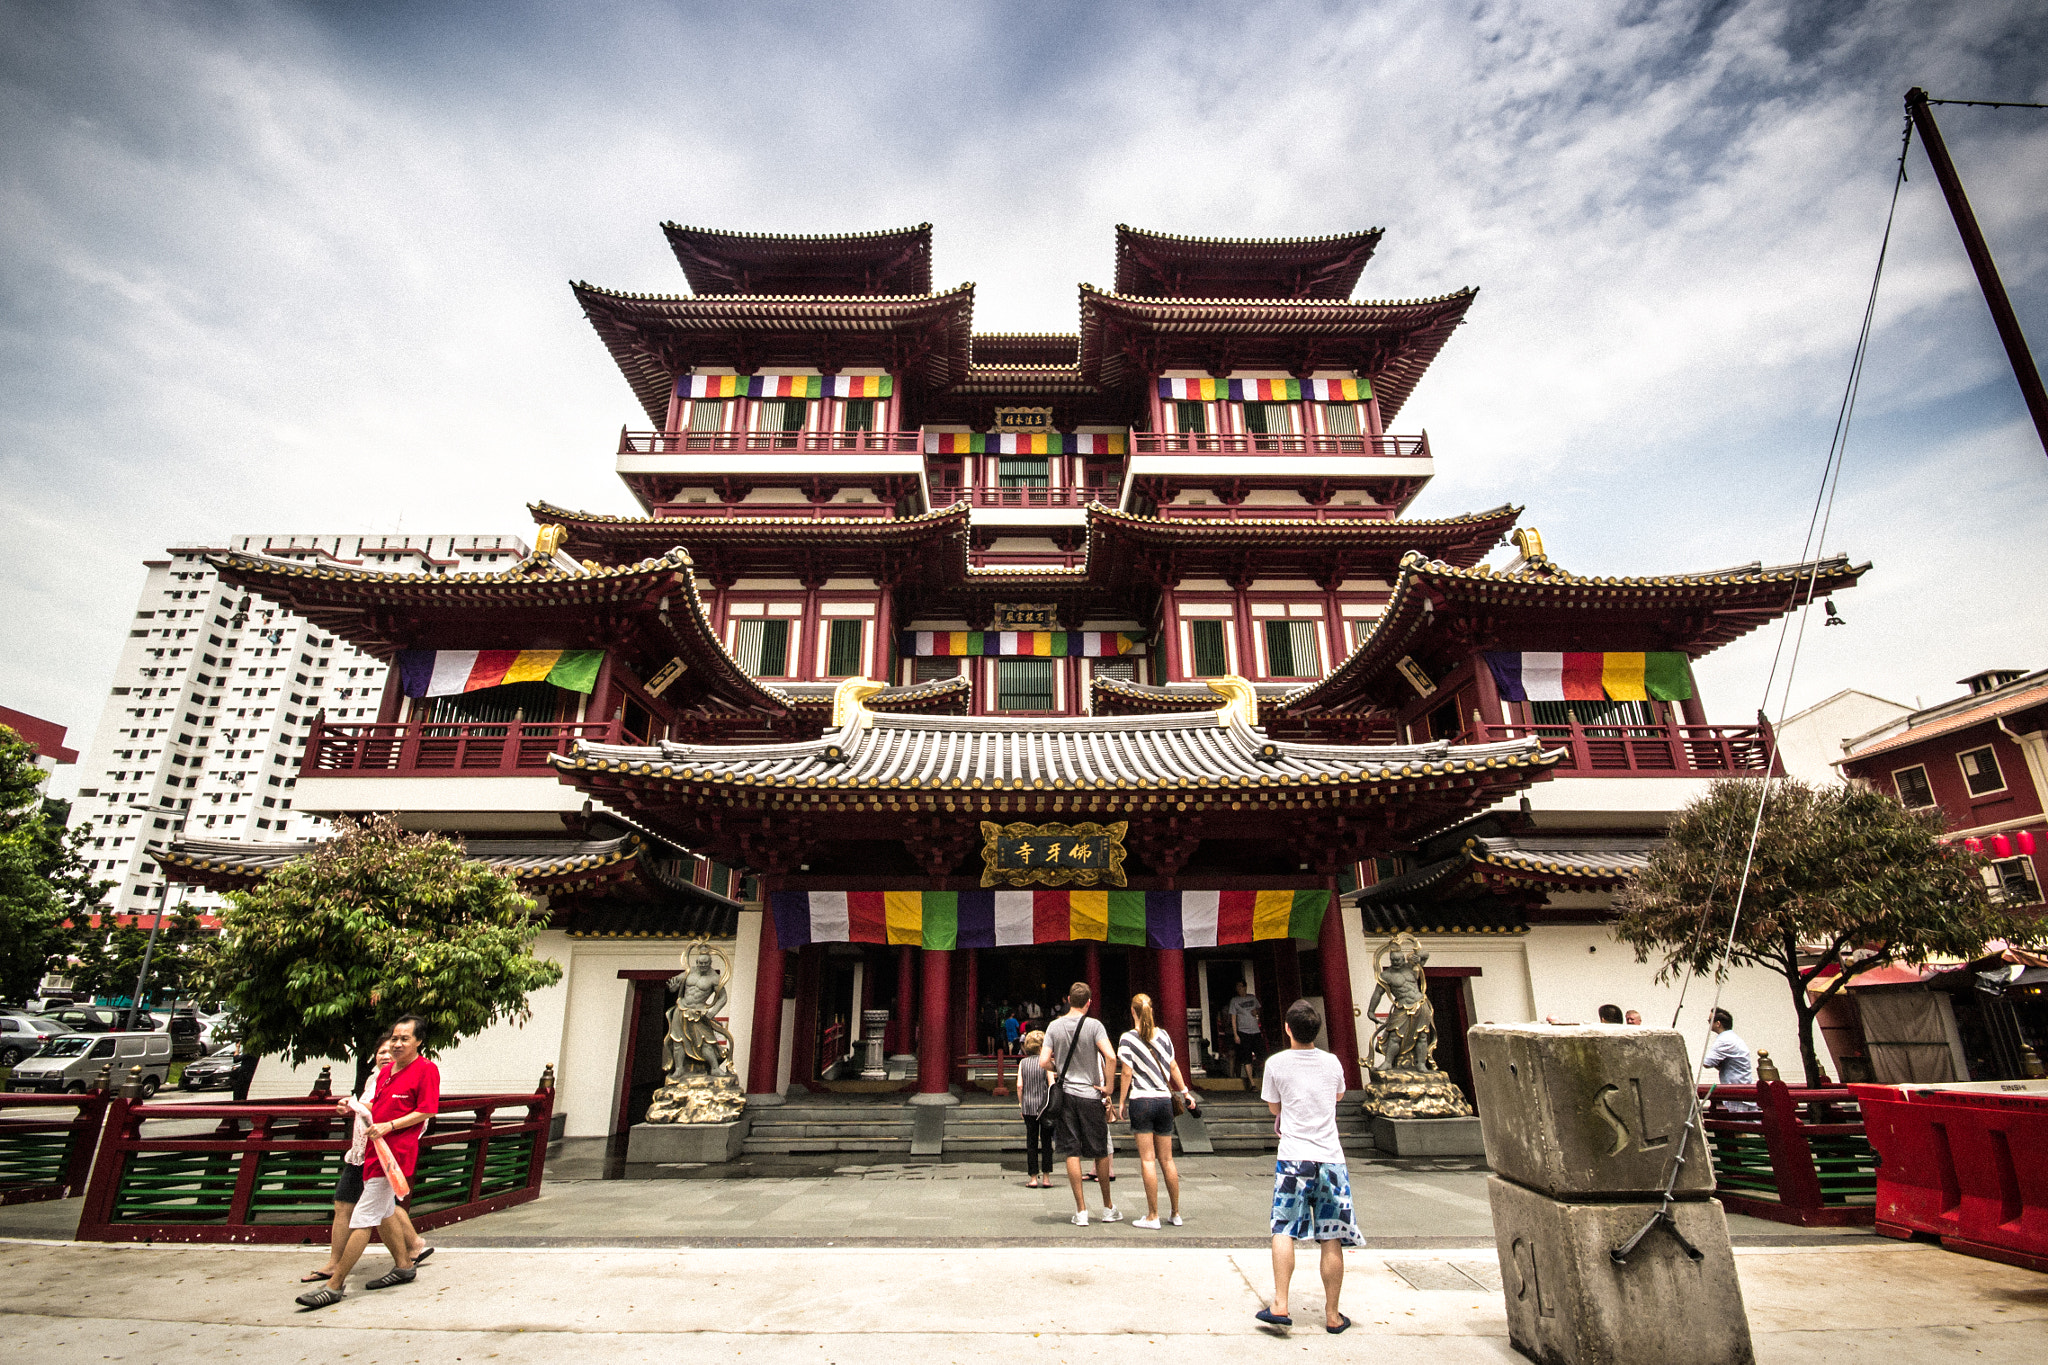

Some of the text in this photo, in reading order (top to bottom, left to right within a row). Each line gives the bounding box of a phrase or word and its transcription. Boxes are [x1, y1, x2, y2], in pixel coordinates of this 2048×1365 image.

[1014, 841, 1093, 865] 佛牙寺
[1592, 1076, 1669, 1157] SL
[1511, 1236, 1556, 1319] SL
